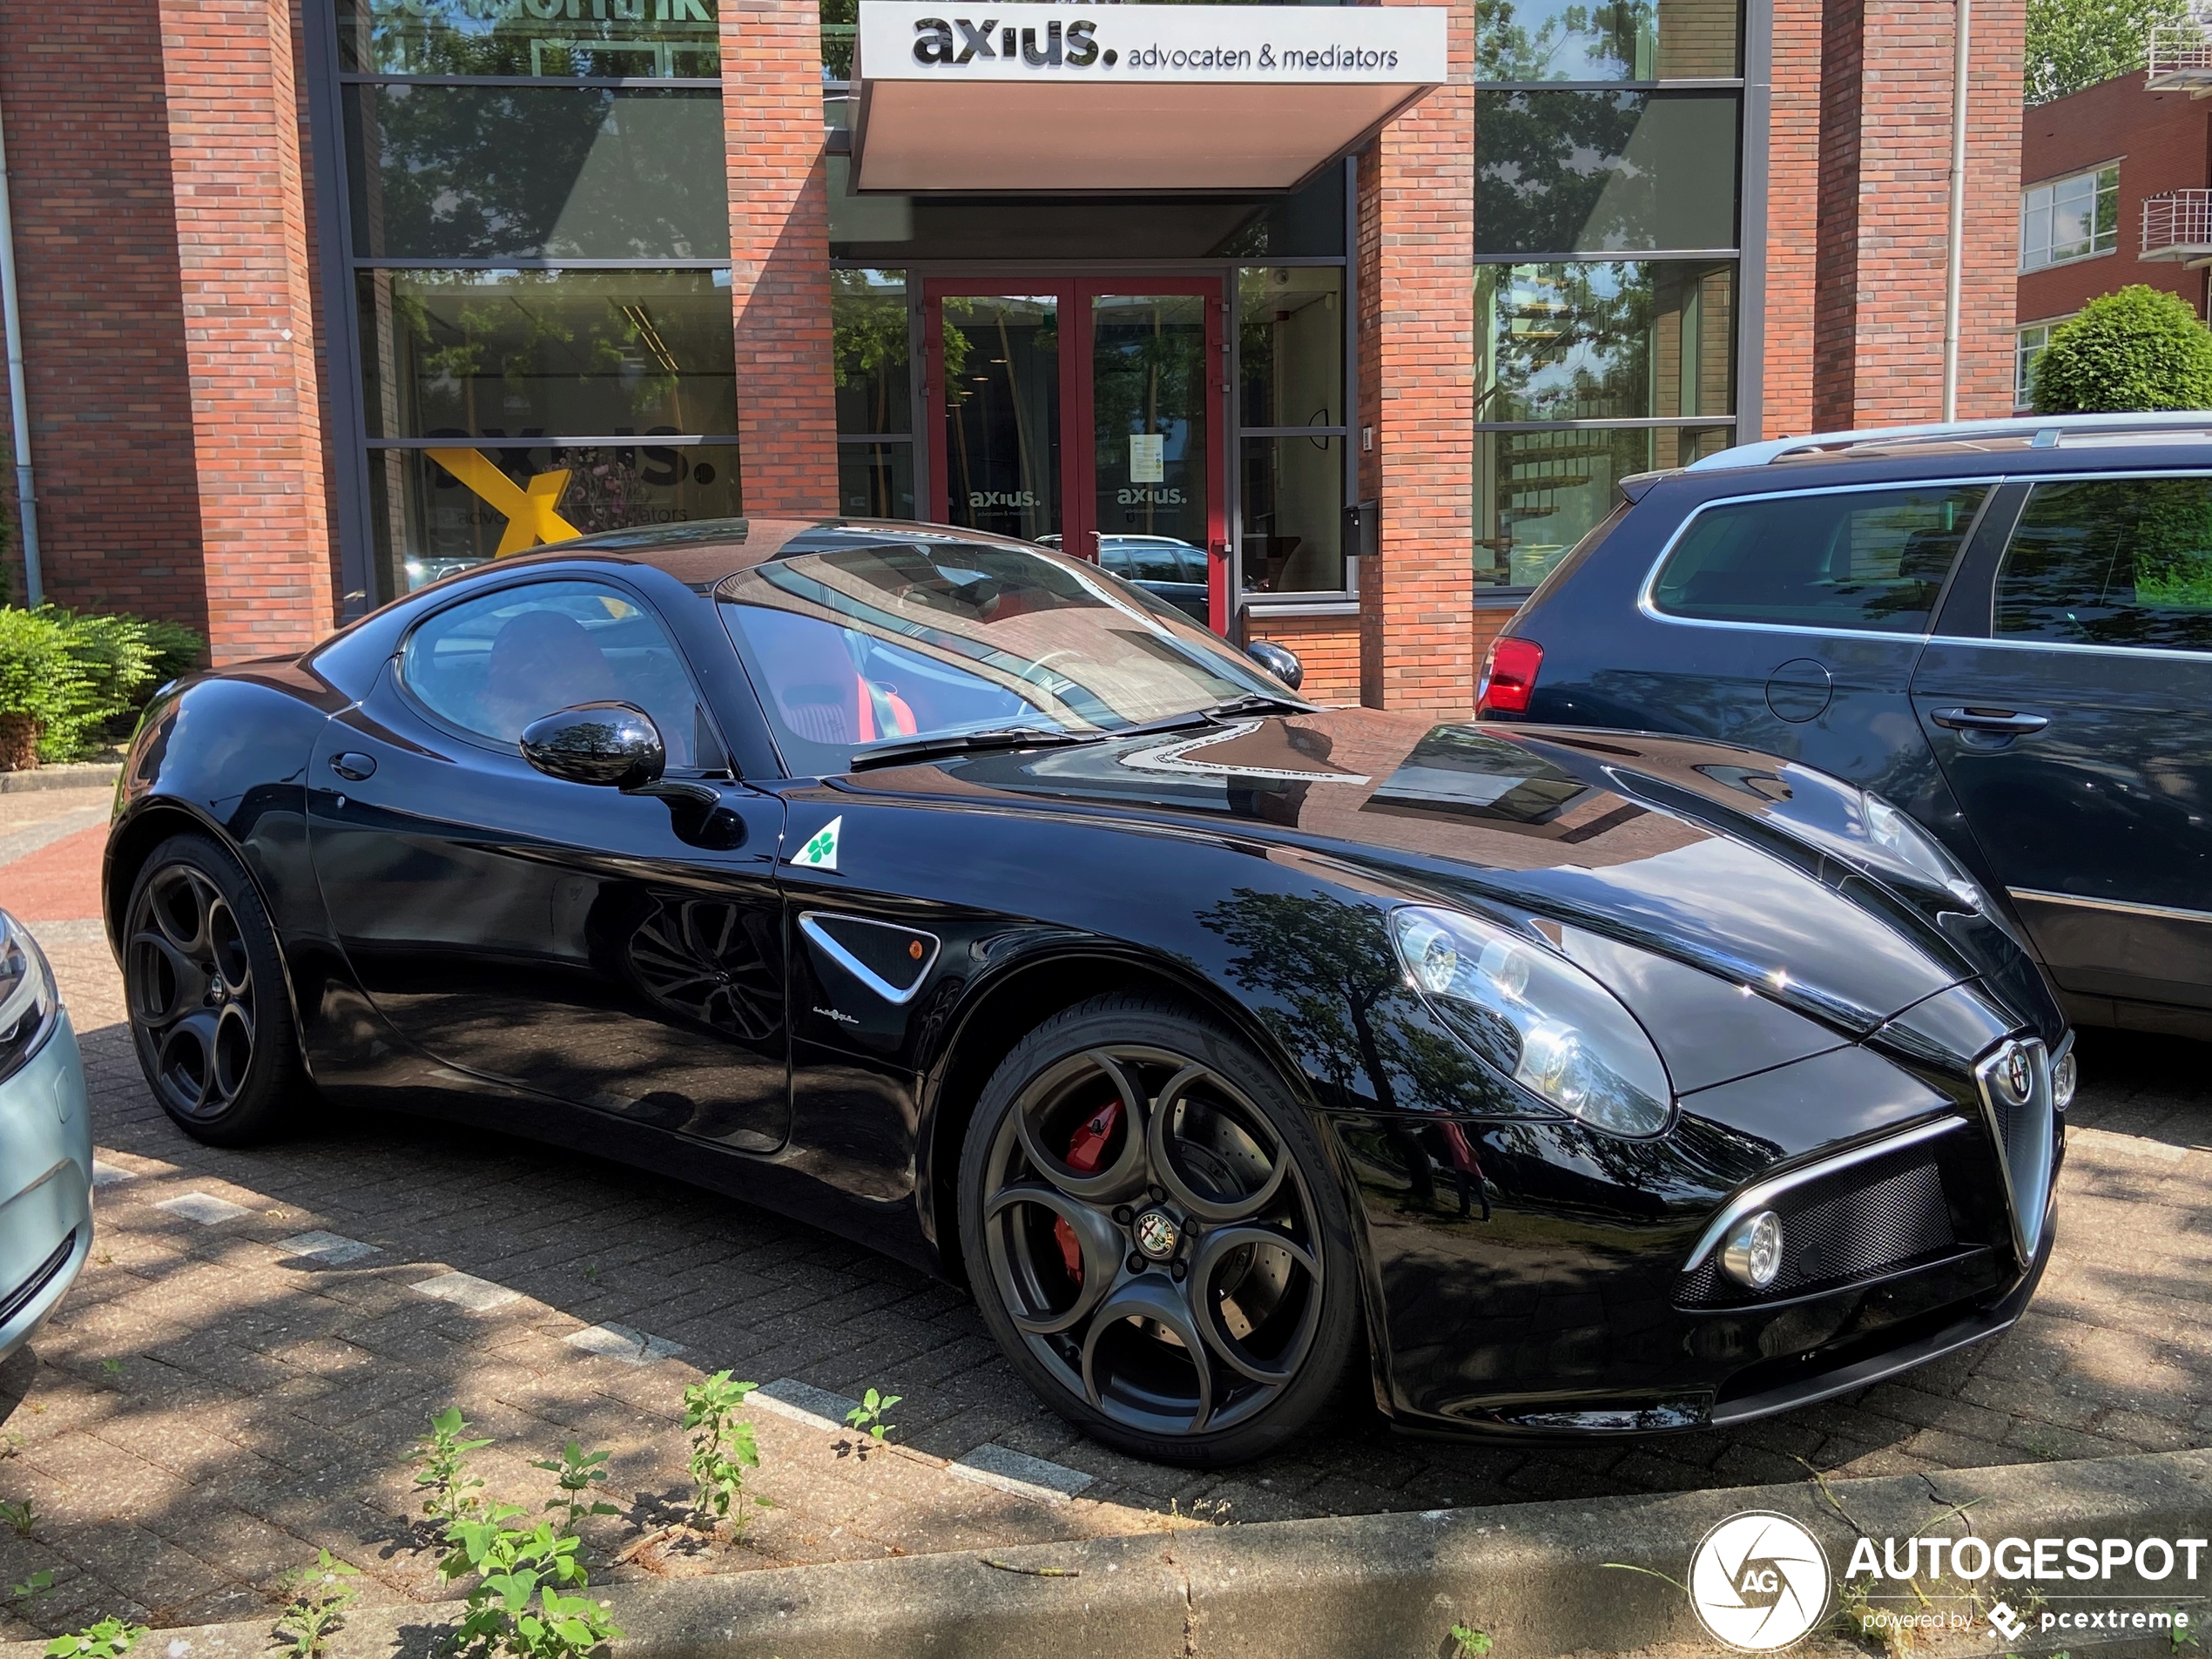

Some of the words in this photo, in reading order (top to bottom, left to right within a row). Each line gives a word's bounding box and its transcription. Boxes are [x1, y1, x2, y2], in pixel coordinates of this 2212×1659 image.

[913, 17, 1118, 66] axius.
[1130, 43, 1250, 67] advocaten
[1259, 44, 1277, 67] &
[1285, 44, 1398, 67] mediators
[969, 490, 1041, 508] axius.
[1116, 488, 1188, 504] axius.
